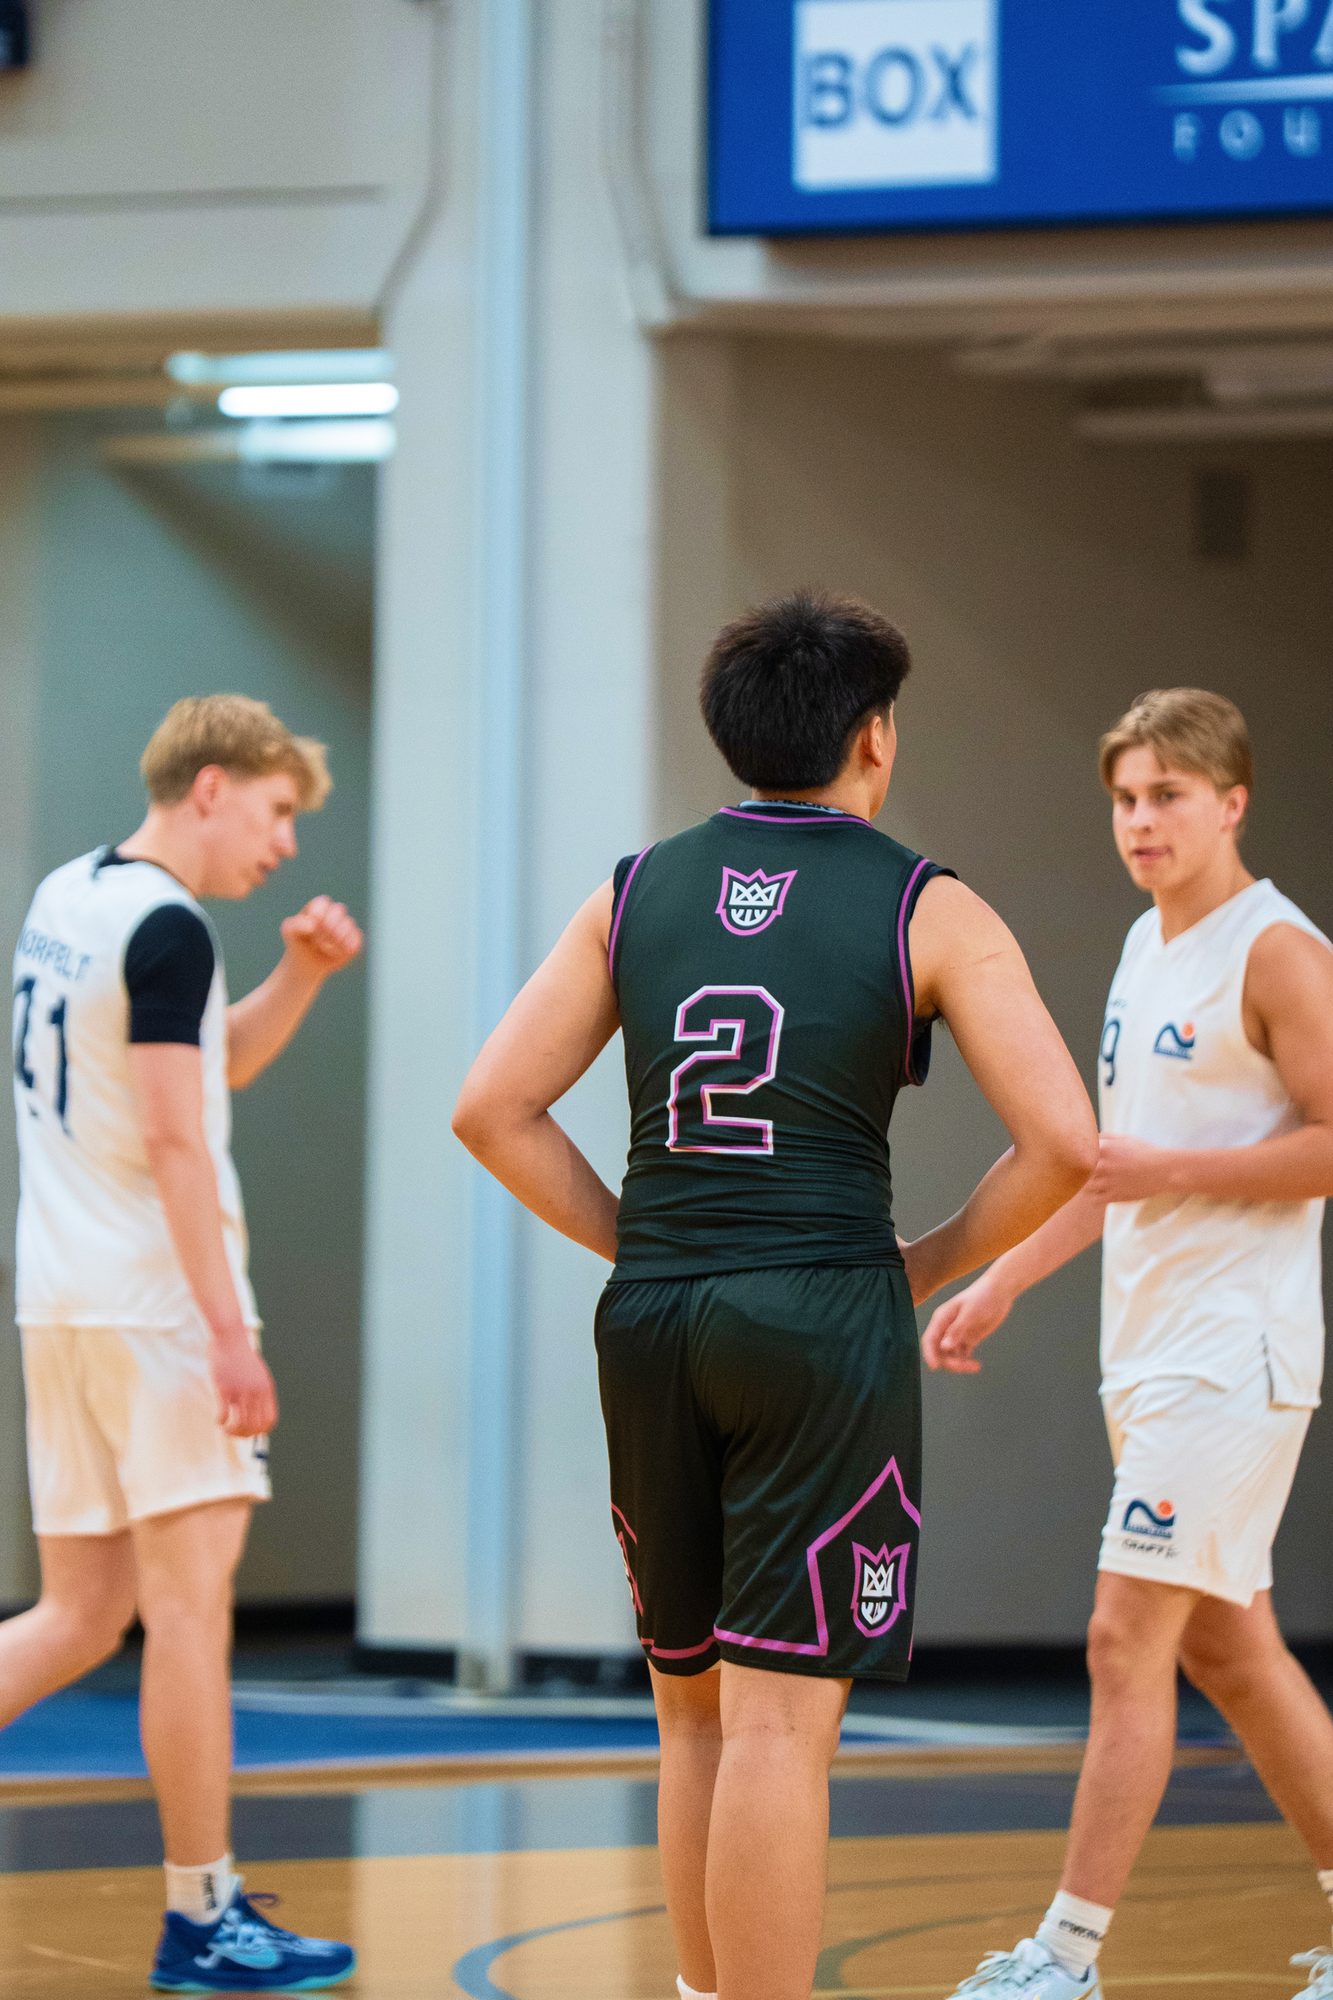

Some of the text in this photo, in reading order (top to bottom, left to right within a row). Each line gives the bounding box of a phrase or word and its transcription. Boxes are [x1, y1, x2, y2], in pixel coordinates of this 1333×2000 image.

[803, 43, 977, 129] BOX
[1173, 108, 1321, 162] FOU
[666, 985, 785, 1155] 2
